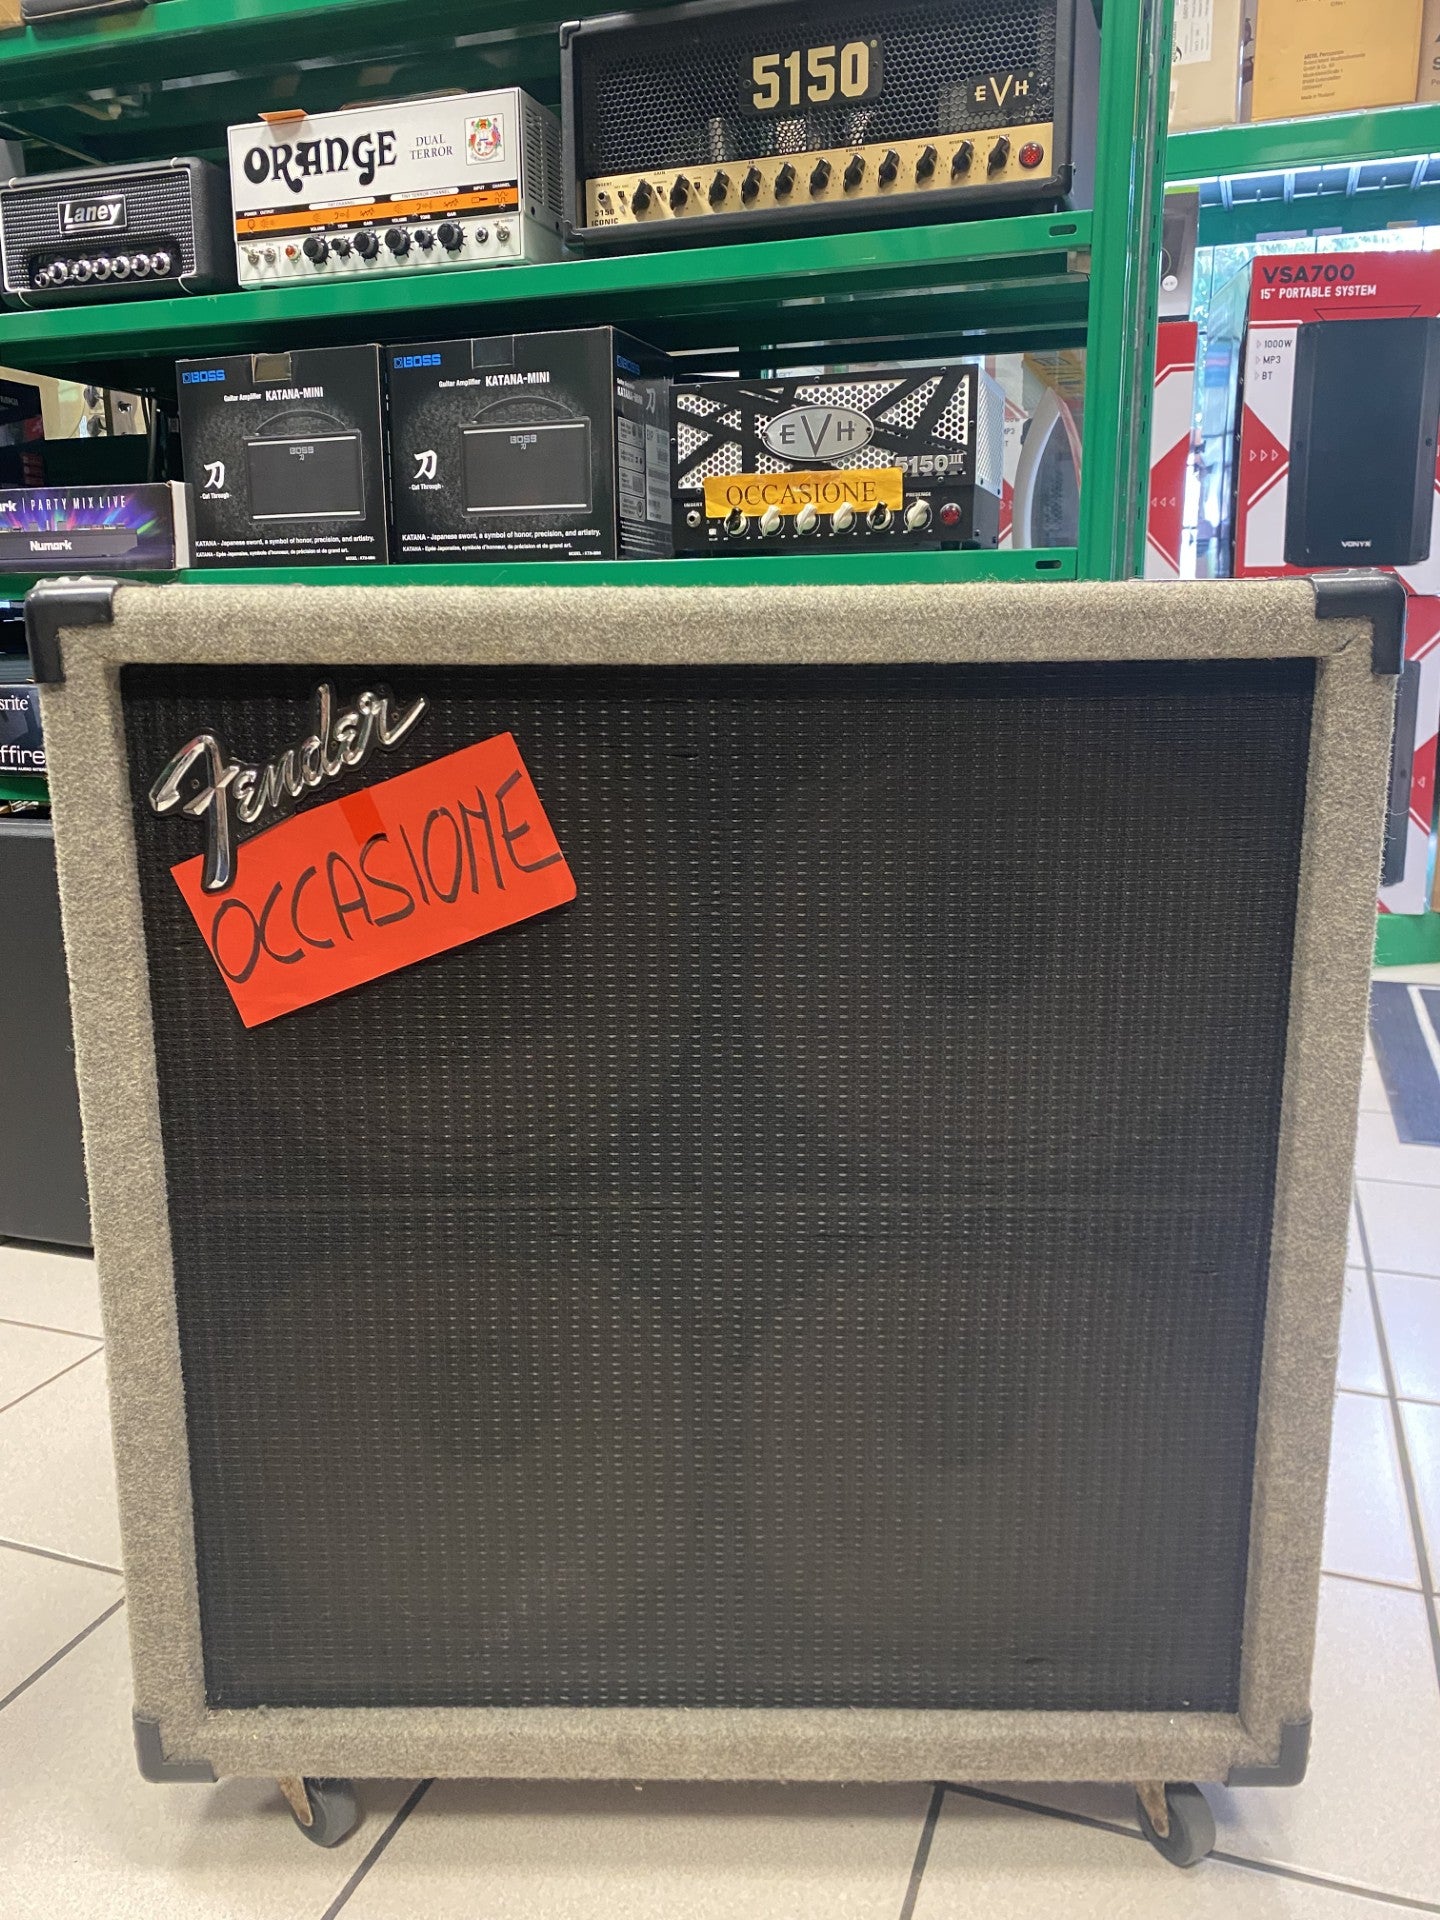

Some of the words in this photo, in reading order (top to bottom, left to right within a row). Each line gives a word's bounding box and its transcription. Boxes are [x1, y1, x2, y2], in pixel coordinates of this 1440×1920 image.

[753, 41, 869, 110] 5150
[974, 74, 1030, 107] EVH
[416, 134, 446, 147] DUAL
[410, 146, 453, 161] TERROR
[244, 131, 398, 193] ORANGE
[63, 202, 122, 225] Laney
[591, 218, 619, 227] ICONIC
[1262, 264, 1355, 284] VSA700
[1279, 286, 1331, 299] PORTABLE
[1335, 285, 1377, 297] SYSTEM
[1264, 340, 1292, 348] 1000W
[403, 353, 442, 368] BOSS
[1263, 356, 1281, 364] MP3
[191, 369, 226, 383] BOSS
[438, 379, 455, 388] Guitar
[456, 378, 481, 388] Amplifier
[485, 371, 550, 387] KATANA-MINI
[1262, 371, 1273, 380] BT
[223, 394, 239, 402] Guitar
[265, 386, 324, 401] KATANA-MINI
[510, 434, 537, 444] BOSS
[780, 413, 855, 457] EVH
[413, 449, 438, 480] 刀
[895, 454, 949, 474] 5150
[204, 460, 226, 489] 刀
[726, 481, 878, 506] OCCASIONE
[31, 498, 67, 511] PARTY
[73, 496, 94, 509] MIX
[99, 495, 126, 509] LIVE
[402, 533, 426, 541] KATANA
[431, 533, 457, 541] Japanese
[484, 531, 506, 540] symbol
[565, 529, 577, 537] and
[30, 540, 72, 551] Numark
[1341, 540, 1372, 548] VONYX
[149, 684, 426, 891] Fender
[211, 769, 563, 984] OCCASIONE
